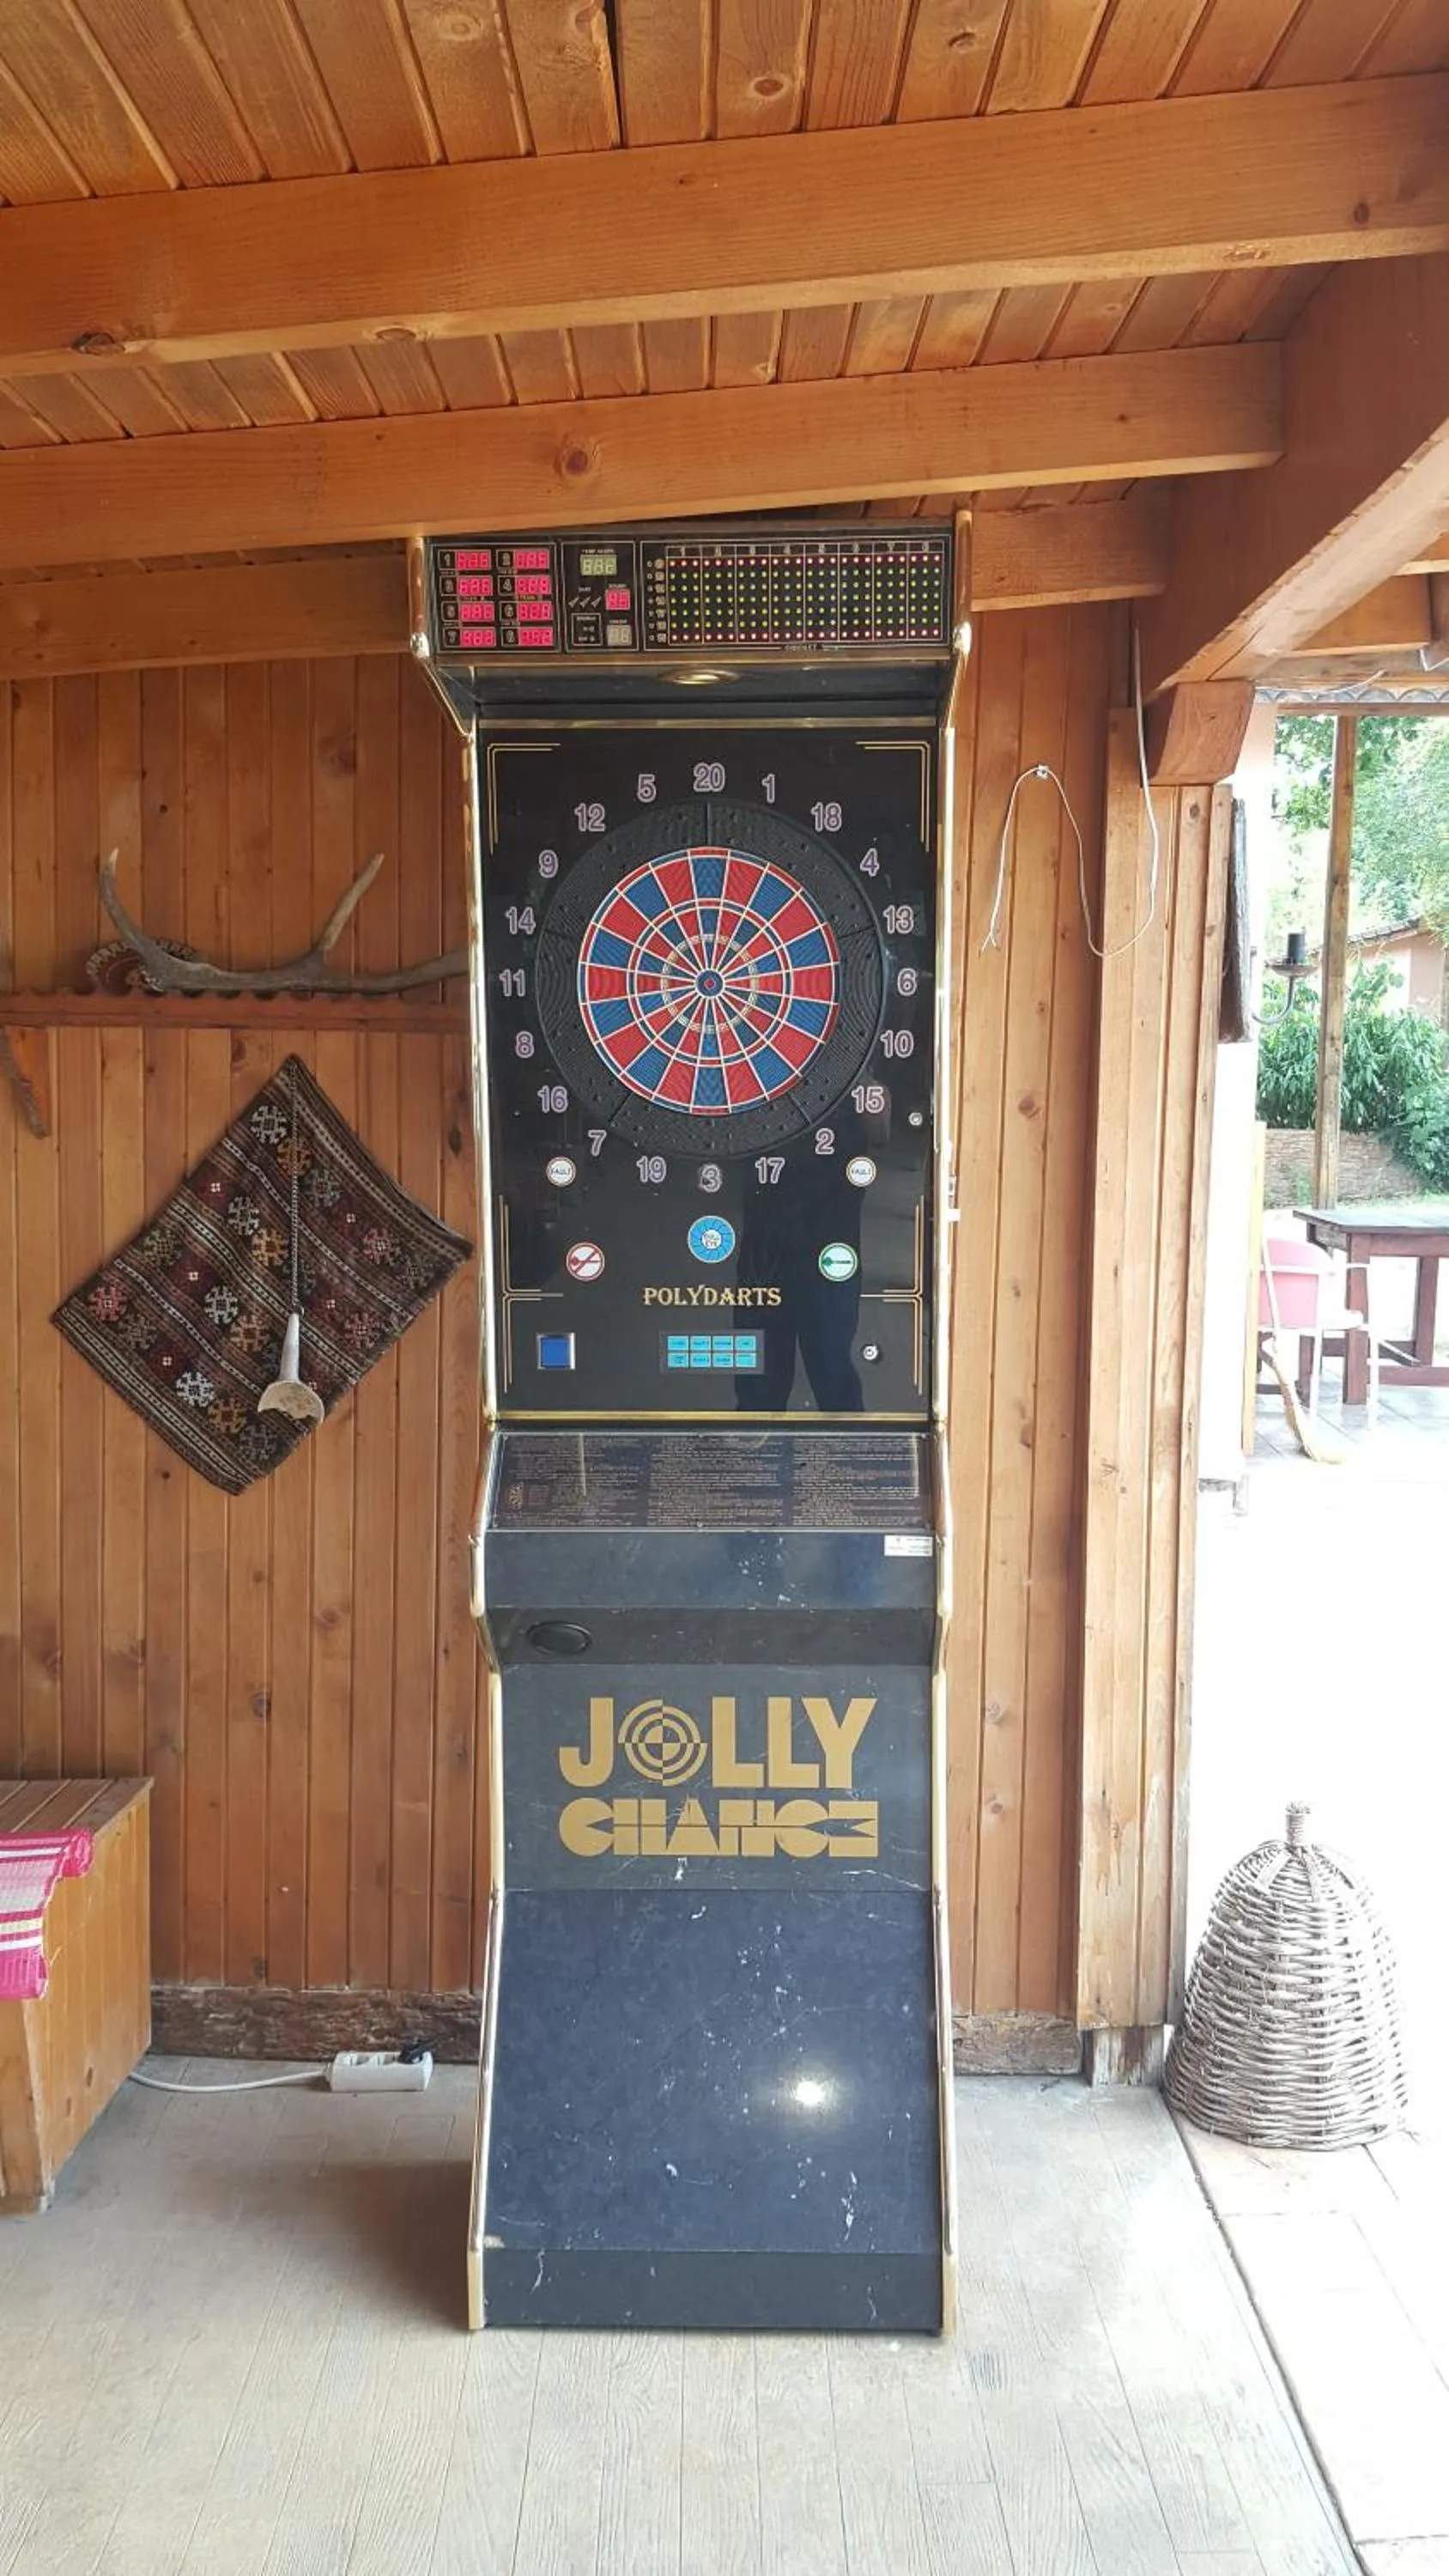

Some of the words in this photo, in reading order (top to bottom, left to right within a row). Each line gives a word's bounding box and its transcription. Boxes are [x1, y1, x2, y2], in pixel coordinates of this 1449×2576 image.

[636, 773, 657, 803] 5
[693, 762, 726, 793] 20
[761, 773, 775, 804] 1
[573, 802, 606, 832] 12
[810, 801, 842, 832] 18
[538, 849, 559, 879] 9
[859, 848, 880, 878] 4
[505, 906, 537, 935] 14
[882, 904, 914, 934] 13
[499, 968, 526, 997] 11
[896, 967, 918, 997] 6
[514, 1030, 535, 1059] 8
[879, 1030, 914, 1059] 10
[537, 1084, 569, 1114] 16
[851, 1084, 885, 1114] 15
[587, 1129, 608, 1157] 7
[815, 1127, 835, 1155] 2
[635, 1155, 667, 1184] 19
[698, 1163, 723, 1193] 3
[755, 1156, 785, 1184] 17
[643, 1284, 782, 1307] POLYDARTS
[559, 1697, 878, 1788] JOLLY
[559, 1797, 879, 1857] CHANCE
